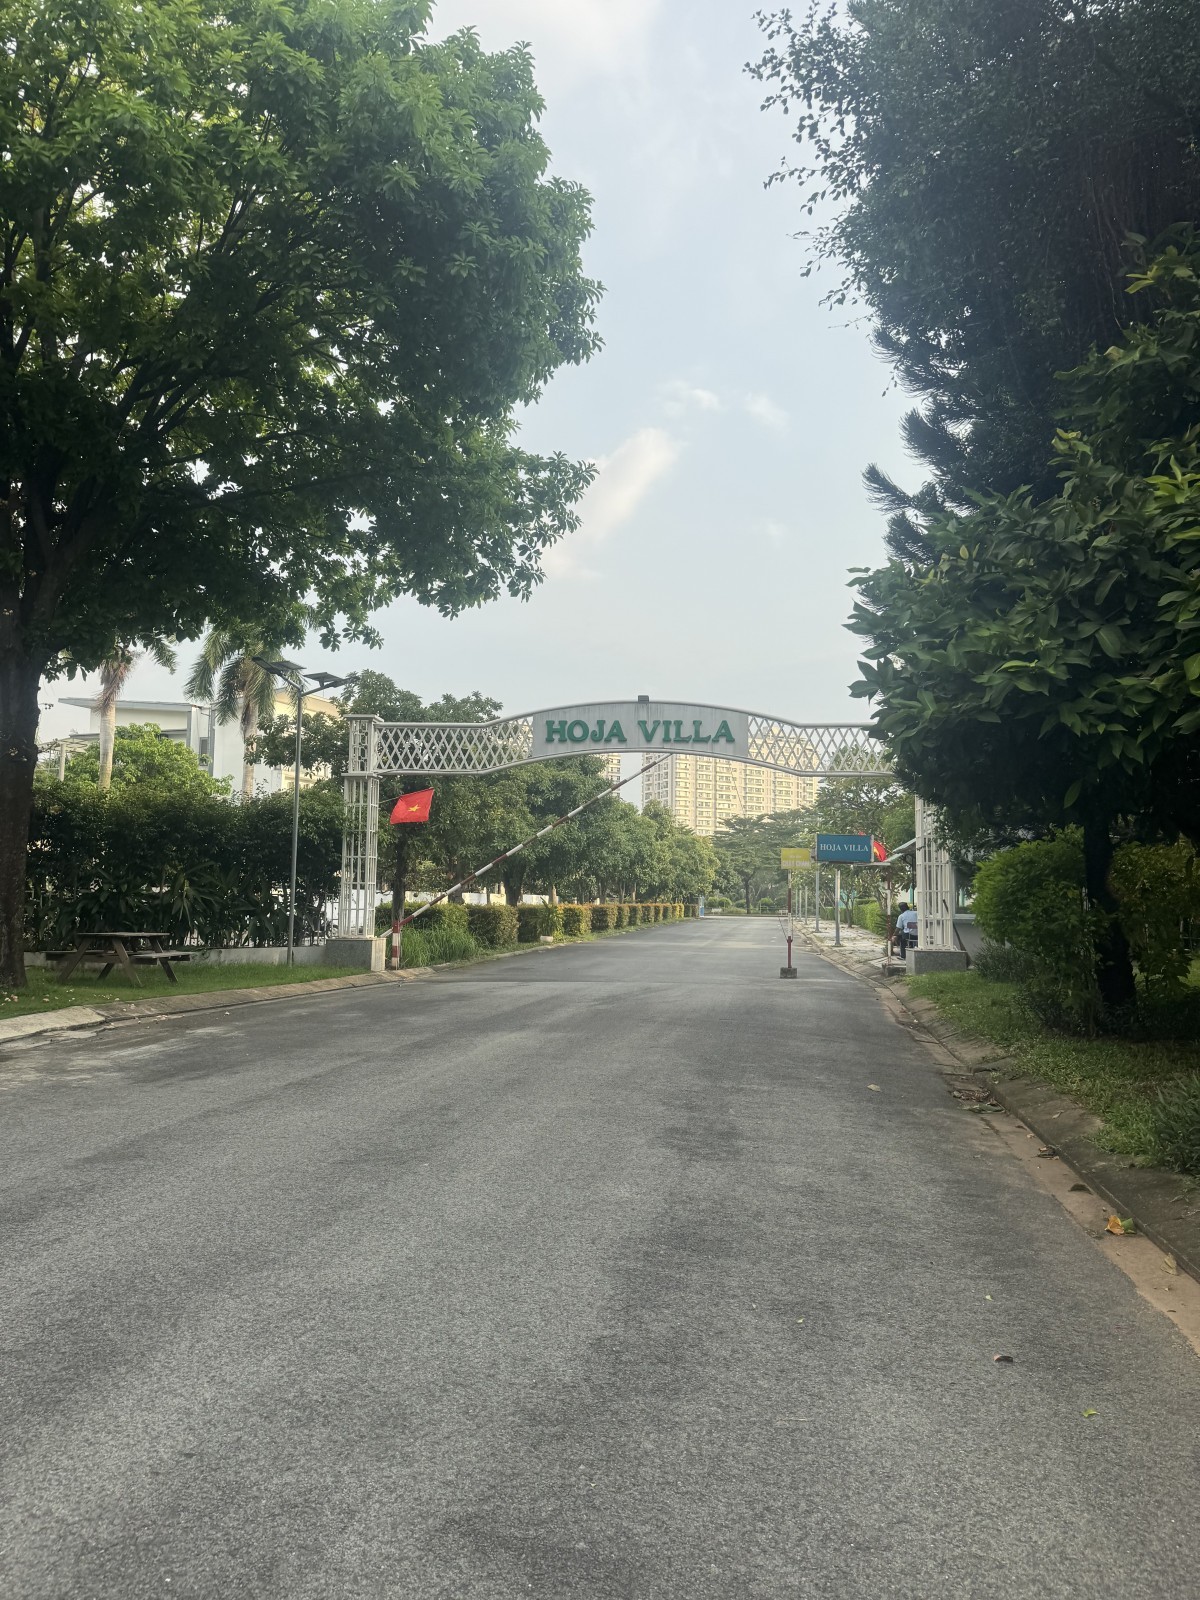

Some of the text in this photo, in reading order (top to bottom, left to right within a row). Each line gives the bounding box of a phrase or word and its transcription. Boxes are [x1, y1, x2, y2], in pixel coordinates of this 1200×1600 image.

[545, 719, 735, 742] HOJA VILLA
[820, 843, 868, 852] HOJA VILLA
